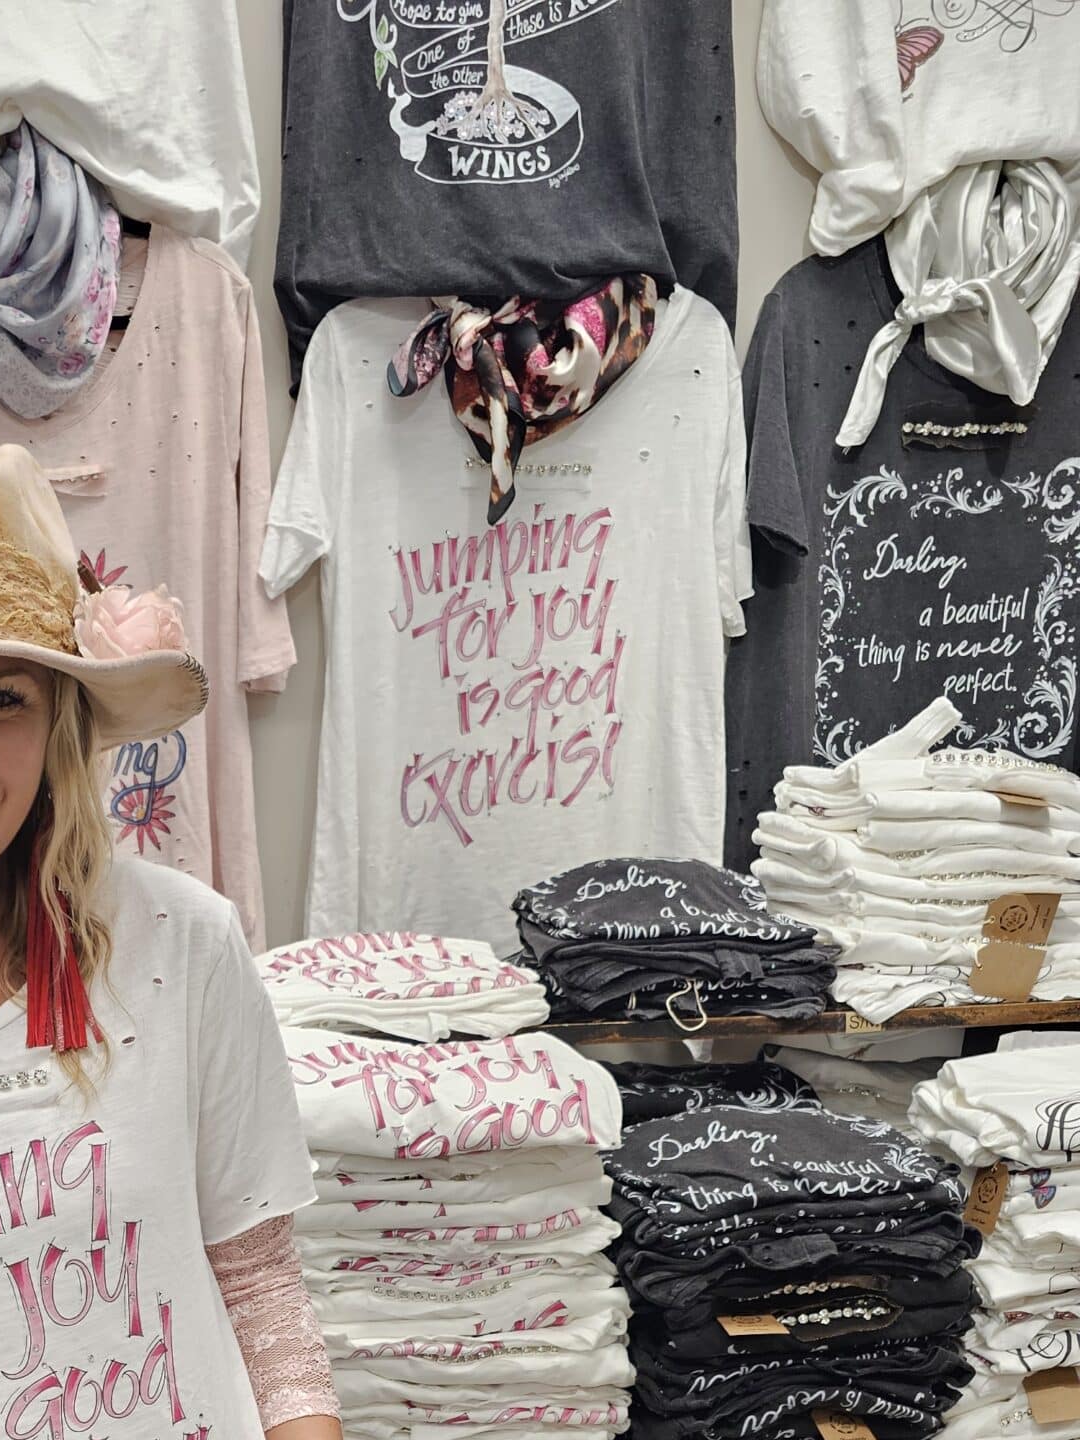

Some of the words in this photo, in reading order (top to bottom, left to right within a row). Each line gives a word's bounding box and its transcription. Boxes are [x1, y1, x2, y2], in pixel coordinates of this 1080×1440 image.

[436, 2, 456, 21] to
[507, 11, 545, 40] these
[549, 1, 563, 21] is
[457, 28, 476, 53] of
[430, 72, 450, 90] the
[448, 145, 551, 179] WINGS
[919, 607, 933, 626] a
[943, 587, 1029, 633] beautiful
[412, 586, 519, 679] for
[854, 634, 906, 682] thing
[916, 640, 931, 662] is
[937, 633, 1023, 658] never
[454, 672, 500, 736] is
[504, 634, 627, 754] good
[943, 662, 1017, 704] perfect.
[331, 1063, 440, 1138] for
[681, 1183, 759, 1212] thing
